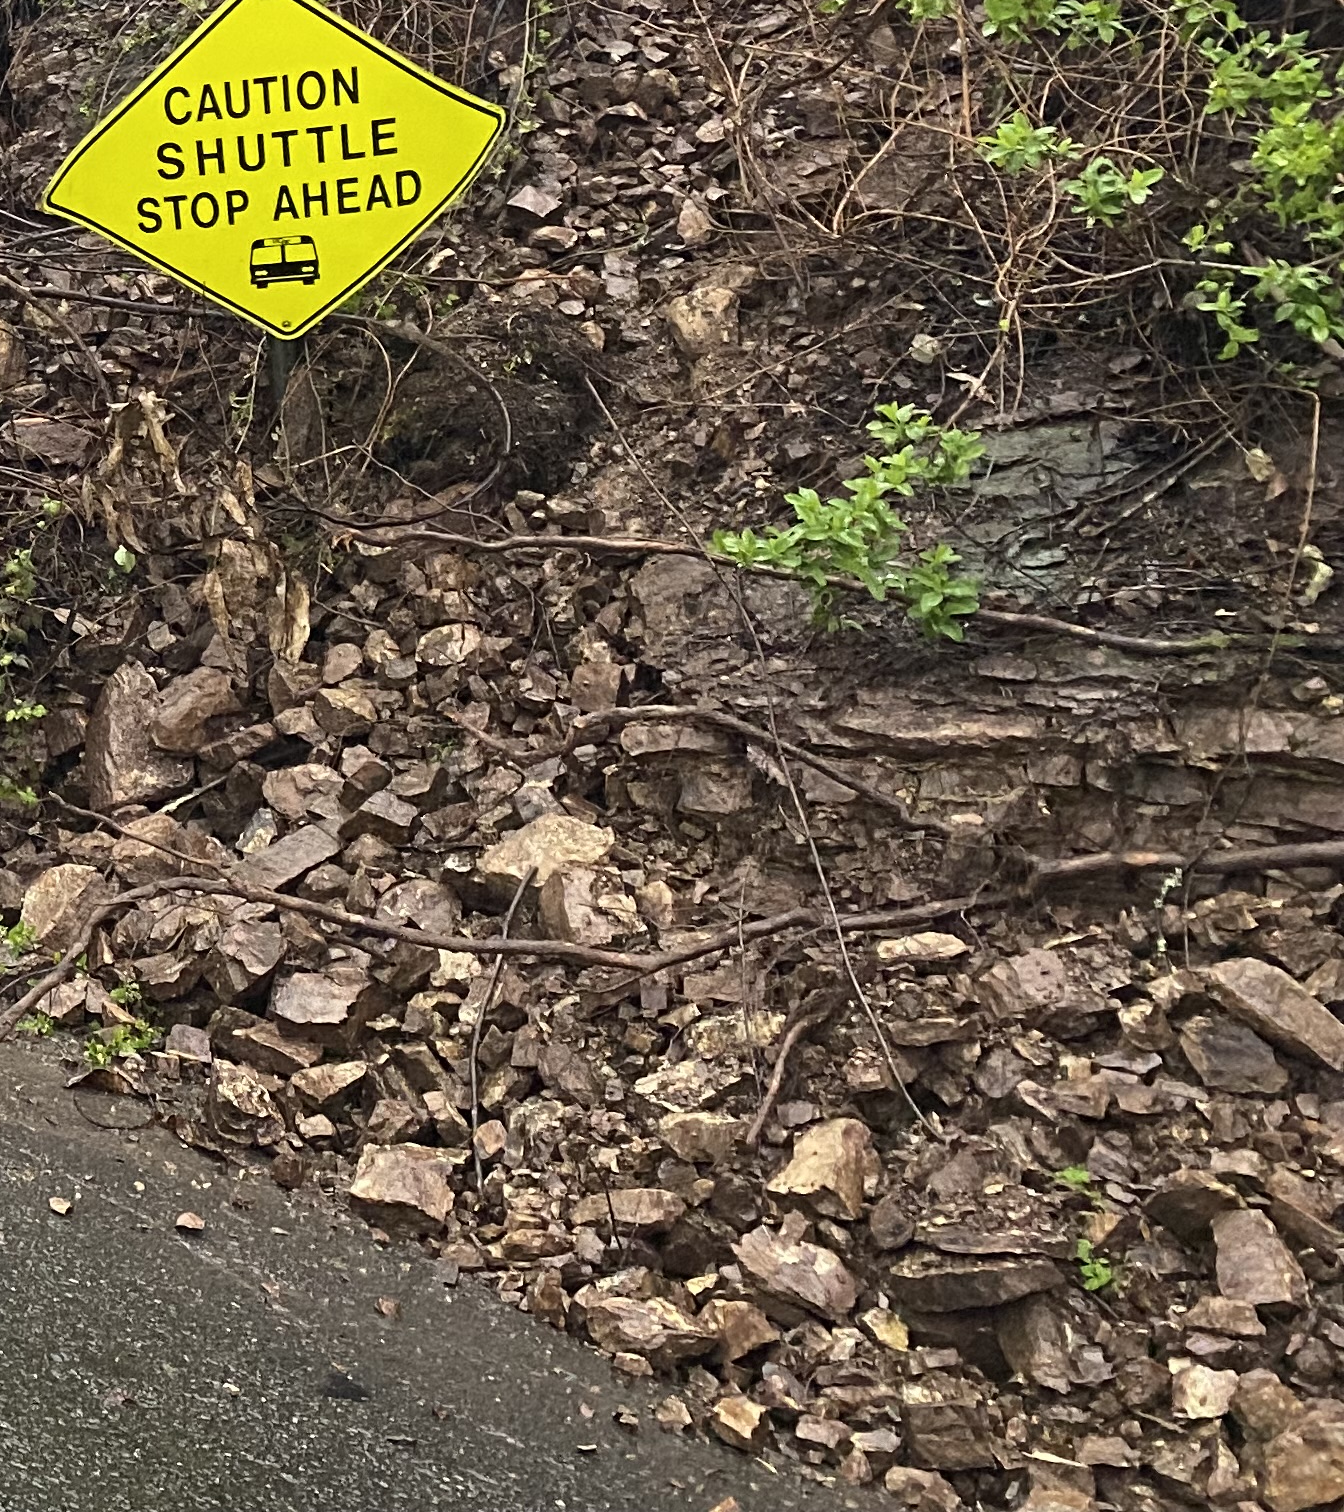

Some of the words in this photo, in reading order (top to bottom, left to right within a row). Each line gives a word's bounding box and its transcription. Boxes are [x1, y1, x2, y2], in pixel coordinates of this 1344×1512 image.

[164, 66, 360, 126] CAUTION
[156, 117, 398, 180] SHUTTLE
[136, 189, 249, 234] STOP
[273, 169, 422, 222] AHEAD
